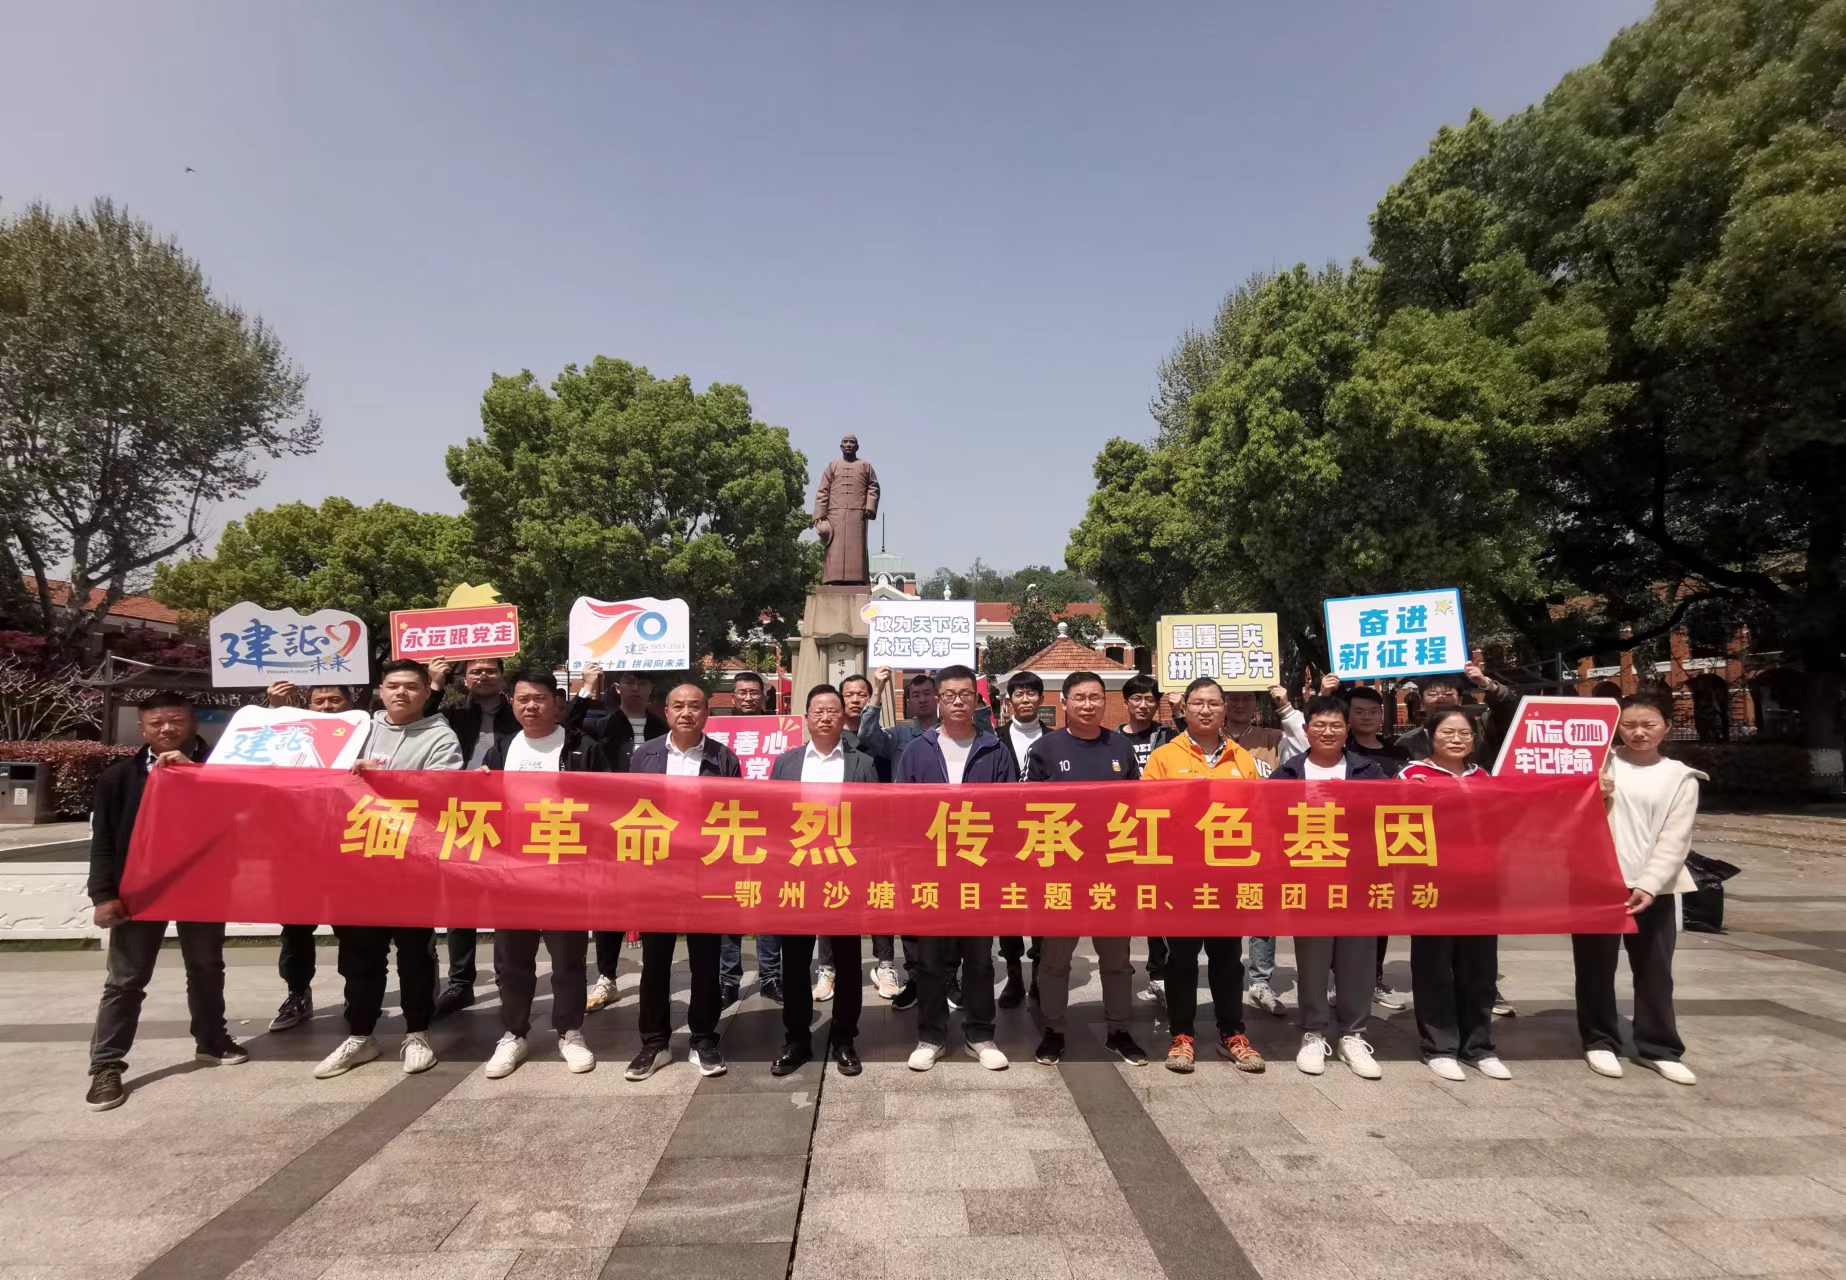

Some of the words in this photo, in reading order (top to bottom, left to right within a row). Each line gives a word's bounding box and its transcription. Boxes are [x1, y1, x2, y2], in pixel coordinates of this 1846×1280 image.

[874, 615, 970, 633] 敢为天下先
[1359, 605, 1428, 637] 奋进
[403, 624, 513, 650] 永远跟党走
[873, 637, 970, 657] 永远争第一
[1173, 623, 1263, 649] 雷霆三实
[310, 655, 352, 675] 未来
[1168, 651, 1273, 680] 拼闯争先
[1339, 636, 1447, 671] 新征程
[1058, 759, 1071, 772] 10
[1514, 747, 1593, 775] 牢记使命
[339, 794, 857, 867] 缅怀革命先烈
[926, 800, 1438, 868] 传承红色基因
